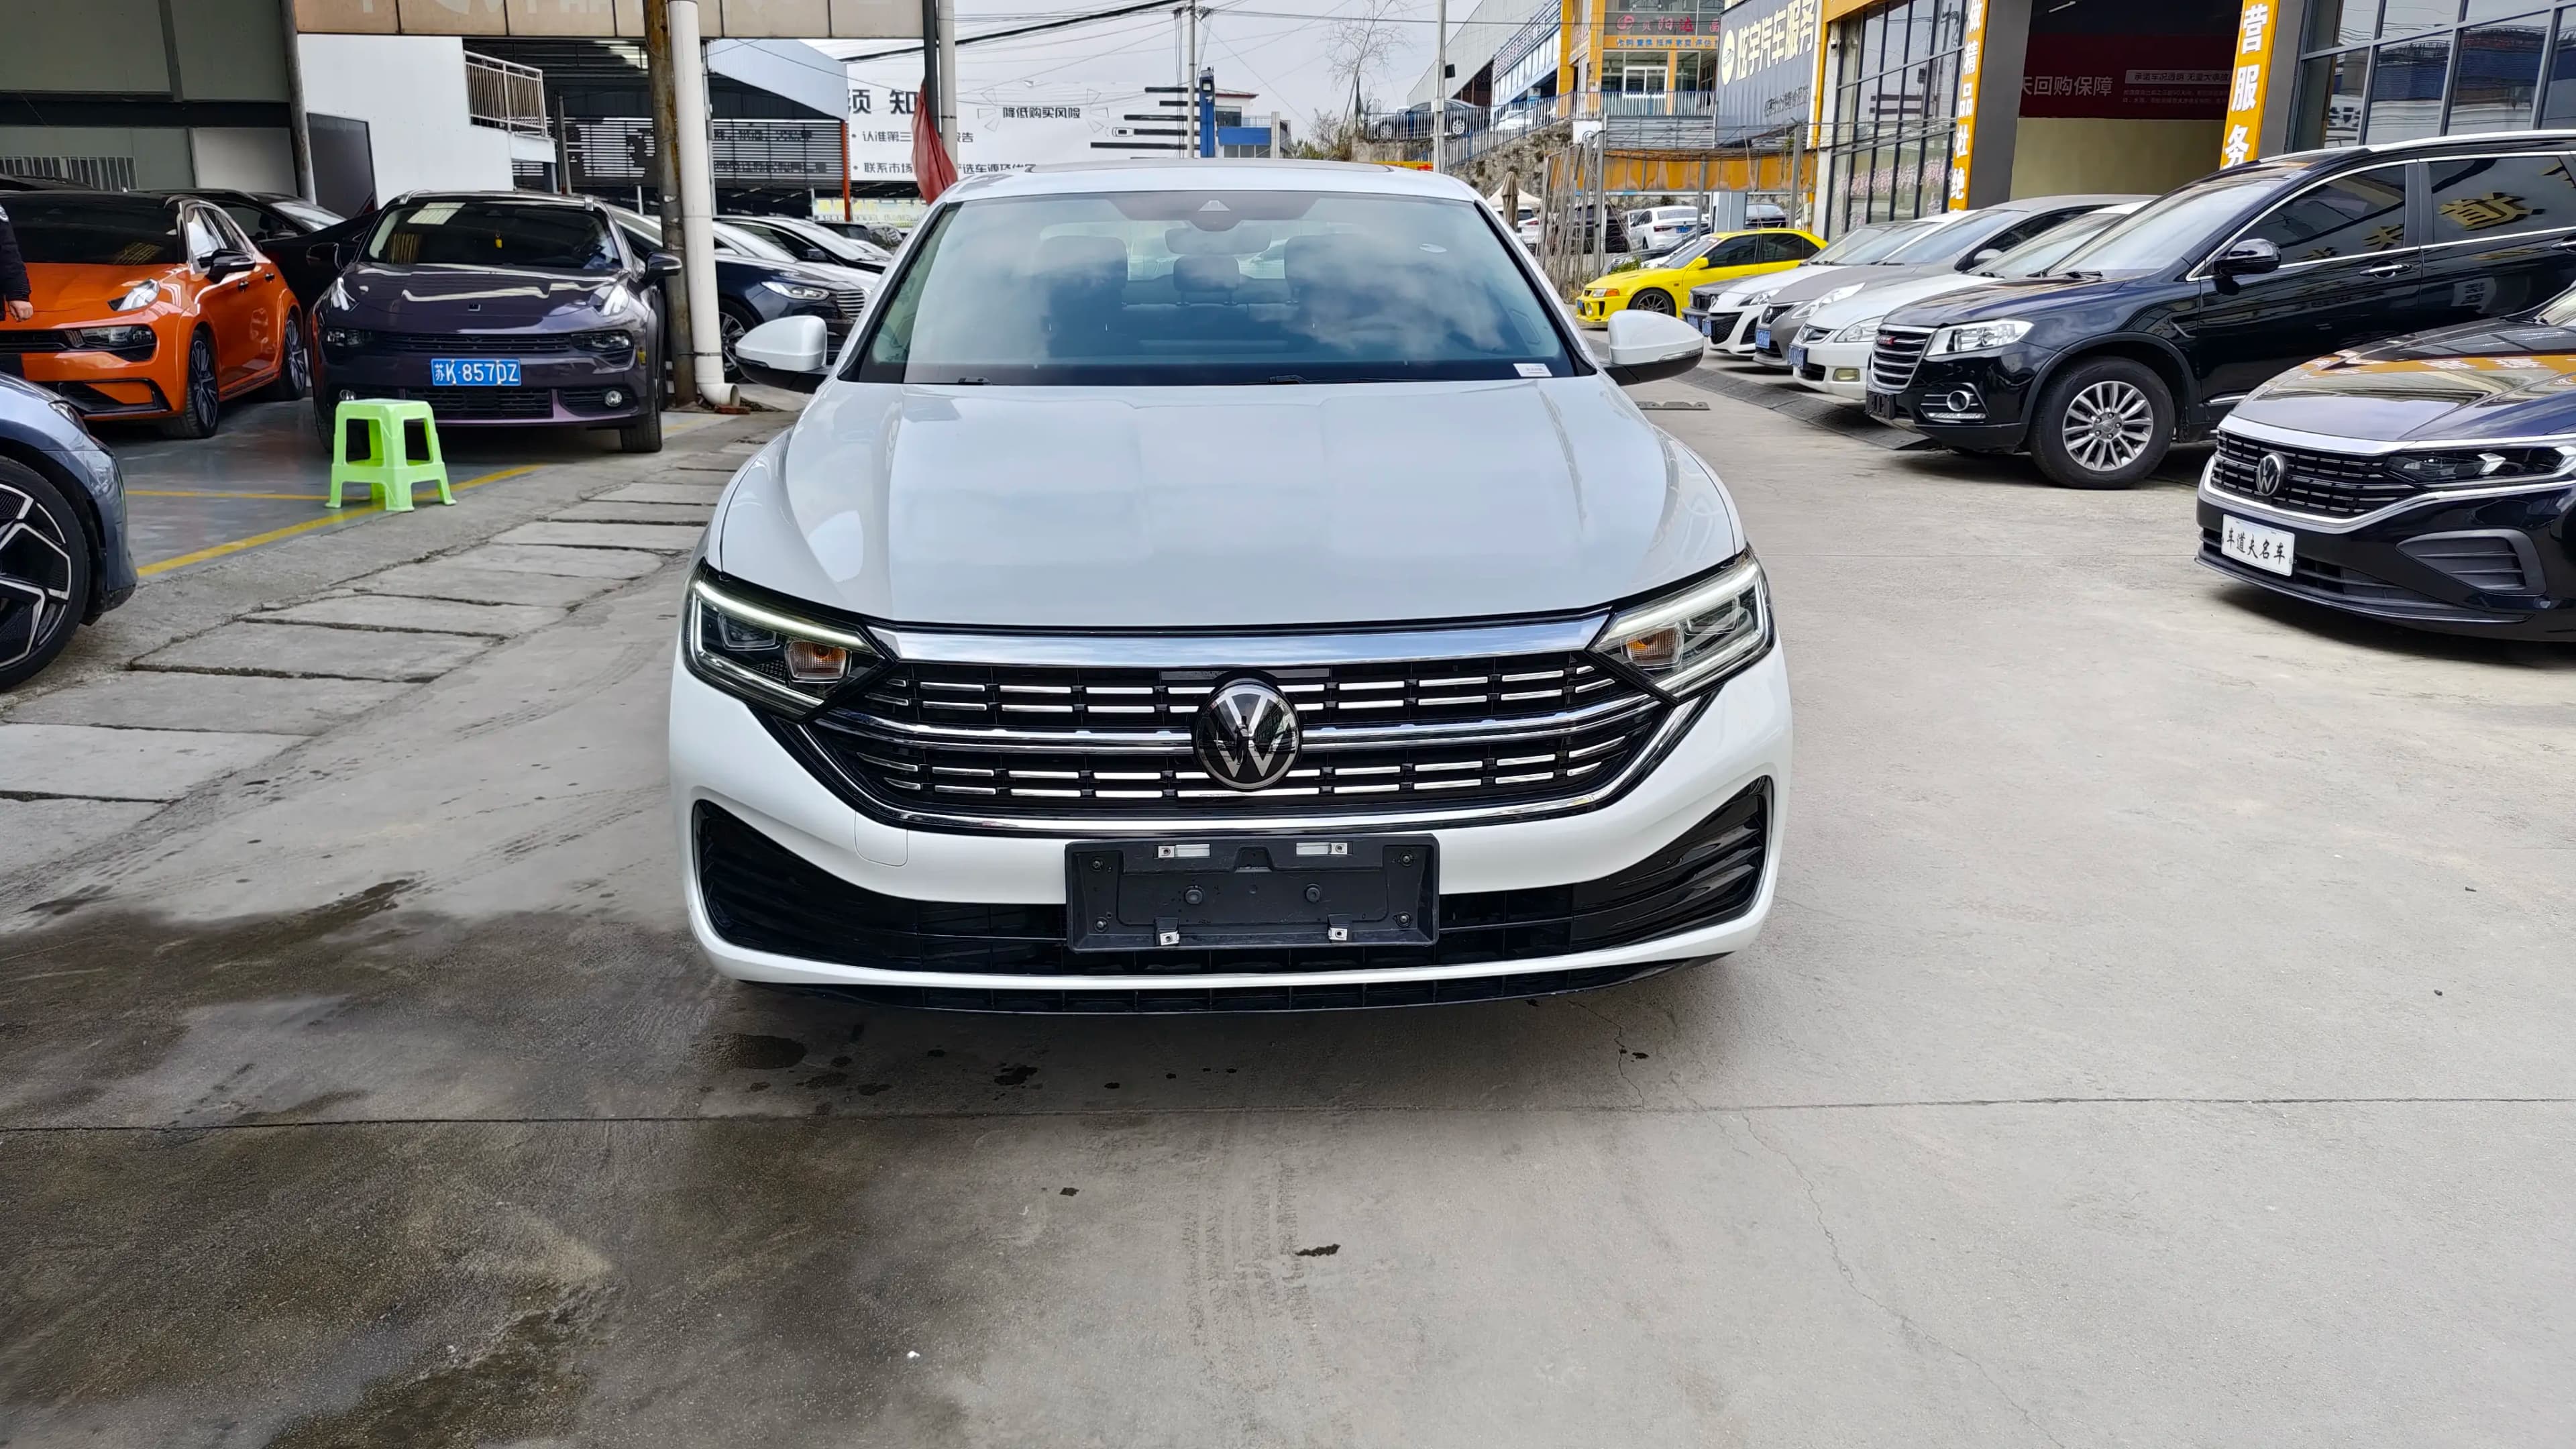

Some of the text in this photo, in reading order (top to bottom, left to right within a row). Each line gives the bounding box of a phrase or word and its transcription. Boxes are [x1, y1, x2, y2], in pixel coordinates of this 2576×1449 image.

[1003, 107, 1081, 118] 降低购买风险
[1949, 0, 1984, 212] 做精品杜绝
